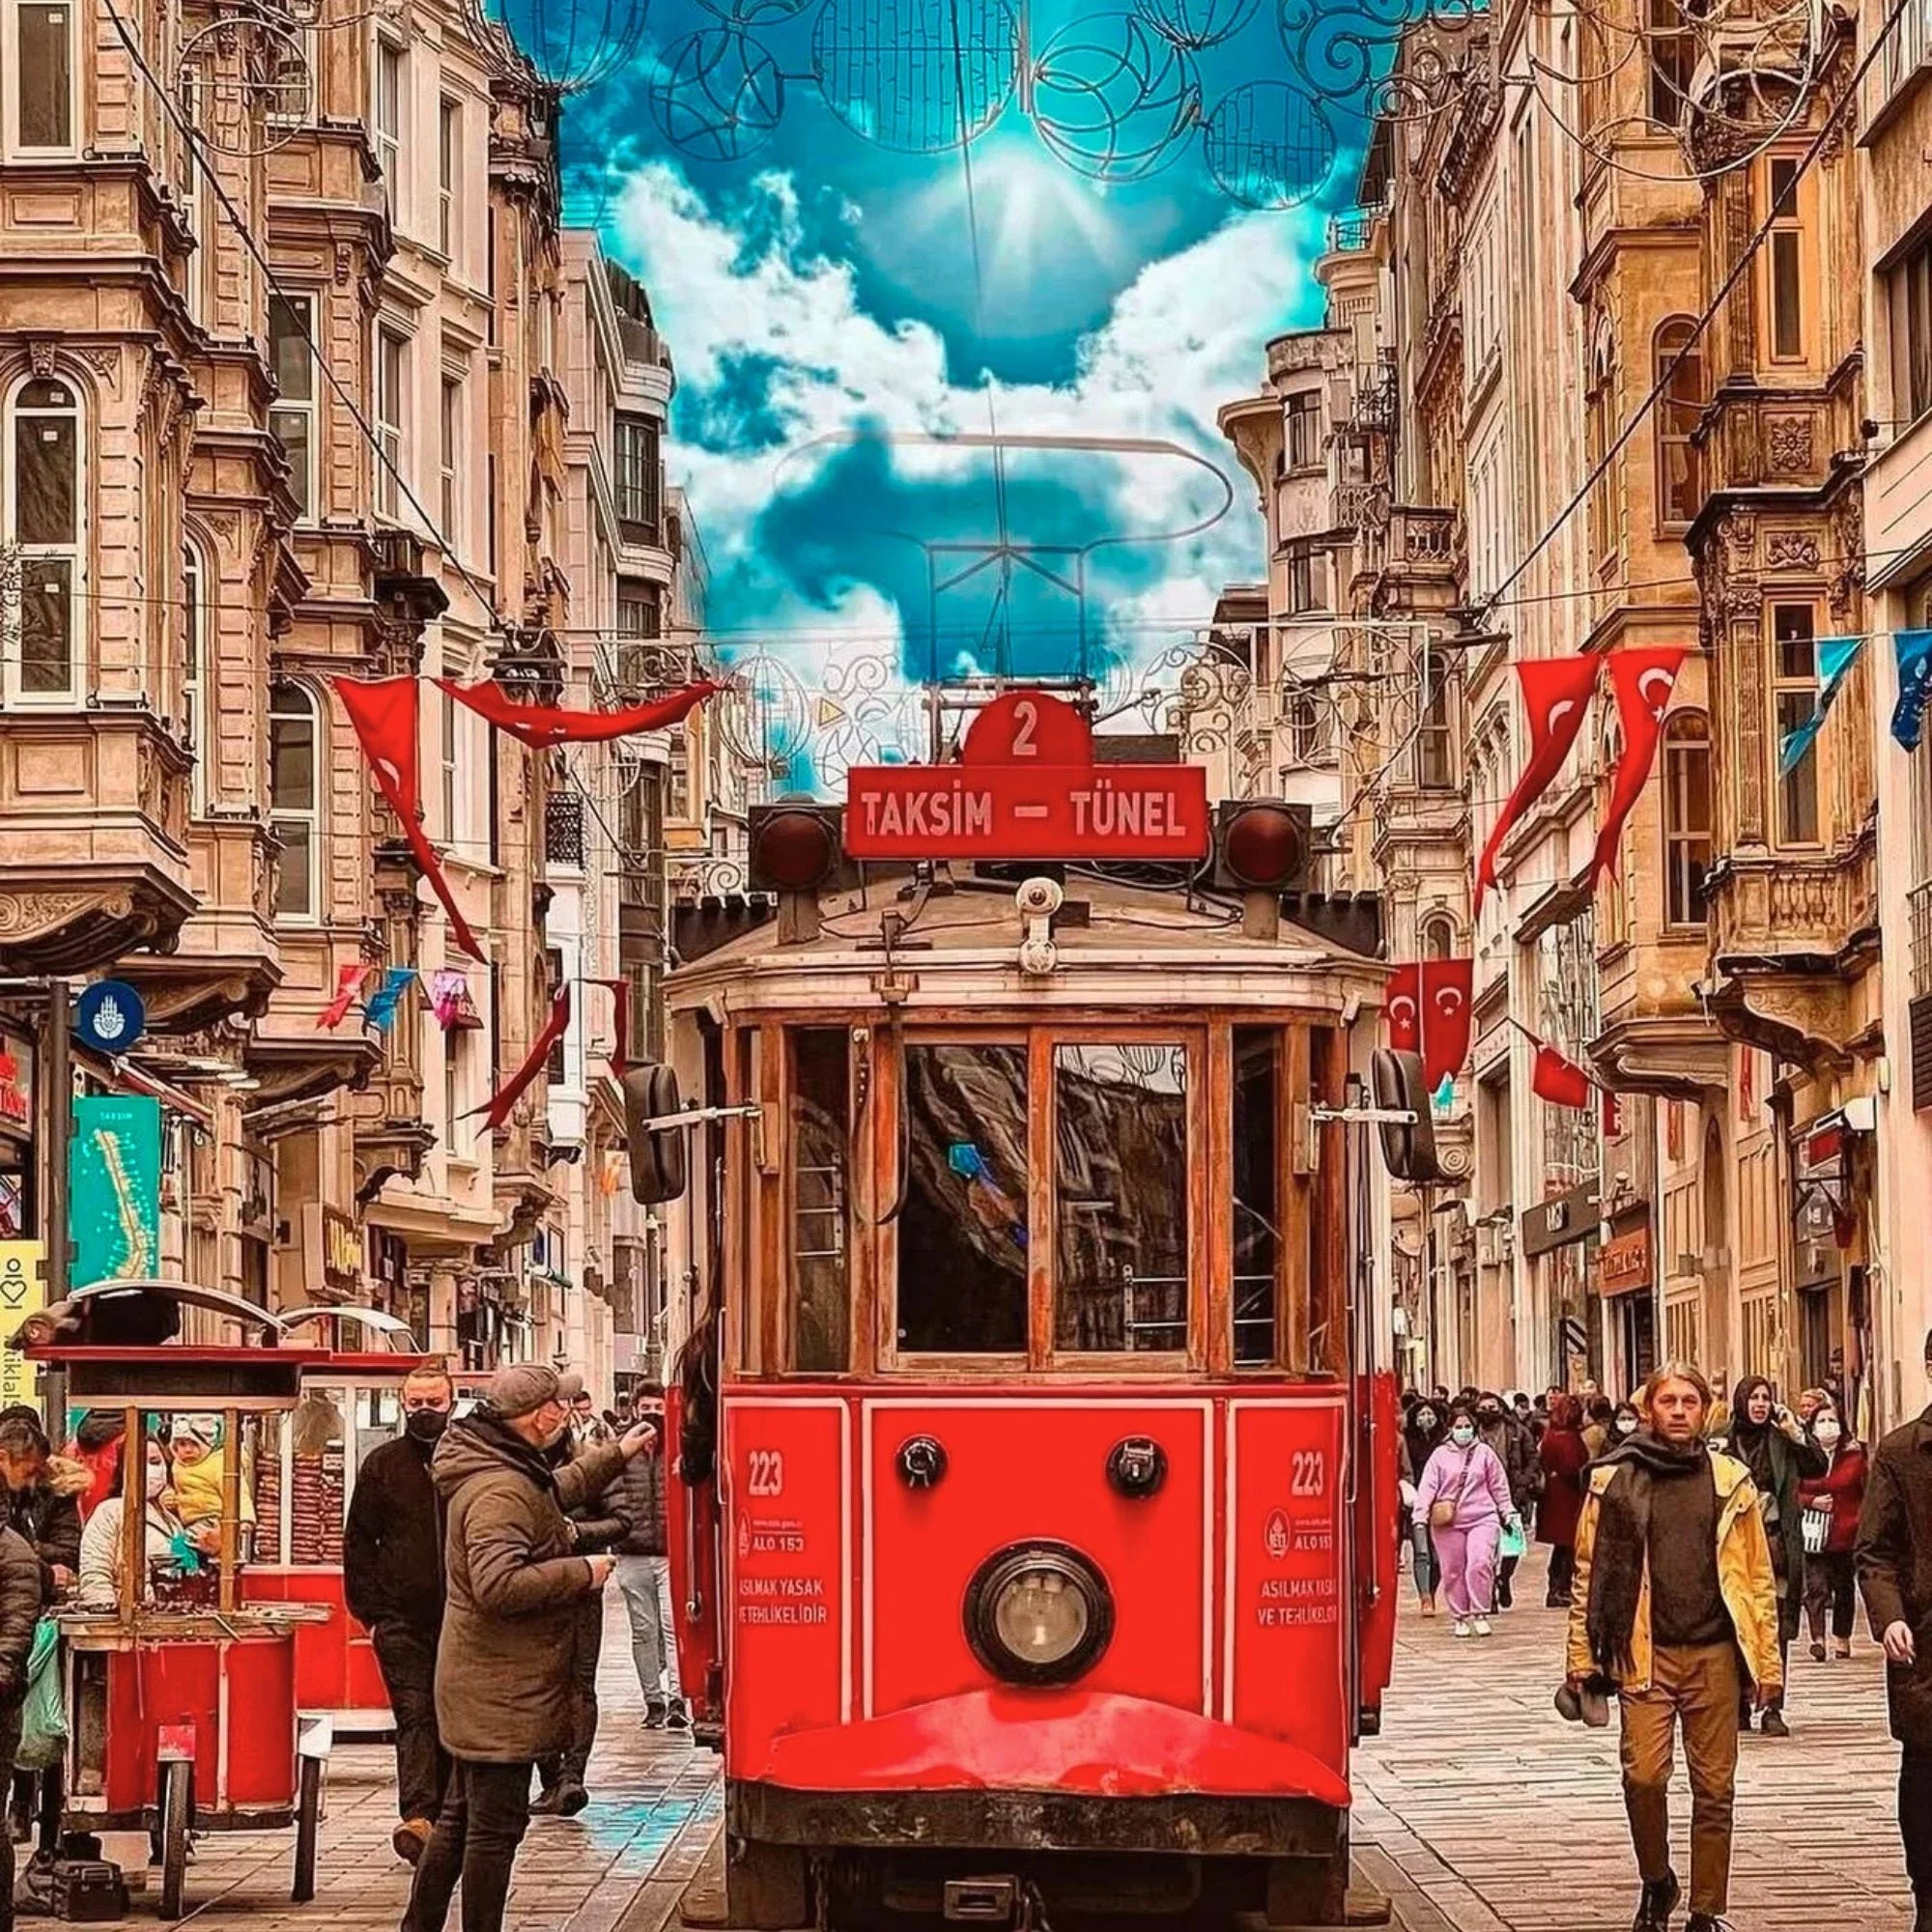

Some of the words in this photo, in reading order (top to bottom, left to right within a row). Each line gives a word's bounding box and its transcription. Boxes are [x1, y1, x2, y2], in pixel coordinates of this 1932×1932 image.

[1012, 700, 1037, 756] 2
[861, 780, 992, 836] TAKSİM
[1070, 780, 1186, 837] TÜNEL
[749, 1451, 782, 1495] 223
[1292, 1451, 1323, 1495] 223
[753, 1536, 775, 1550] ALO
[780, 1537, 804, 1551] 153
[1294, 1535, 1317, 1550] ALO
[780, 1578, 823, 1597] YASAK
[1261, 1579, 1314, 1598] ASILMAK
[1258, 1607, 1275, 1626] VE
